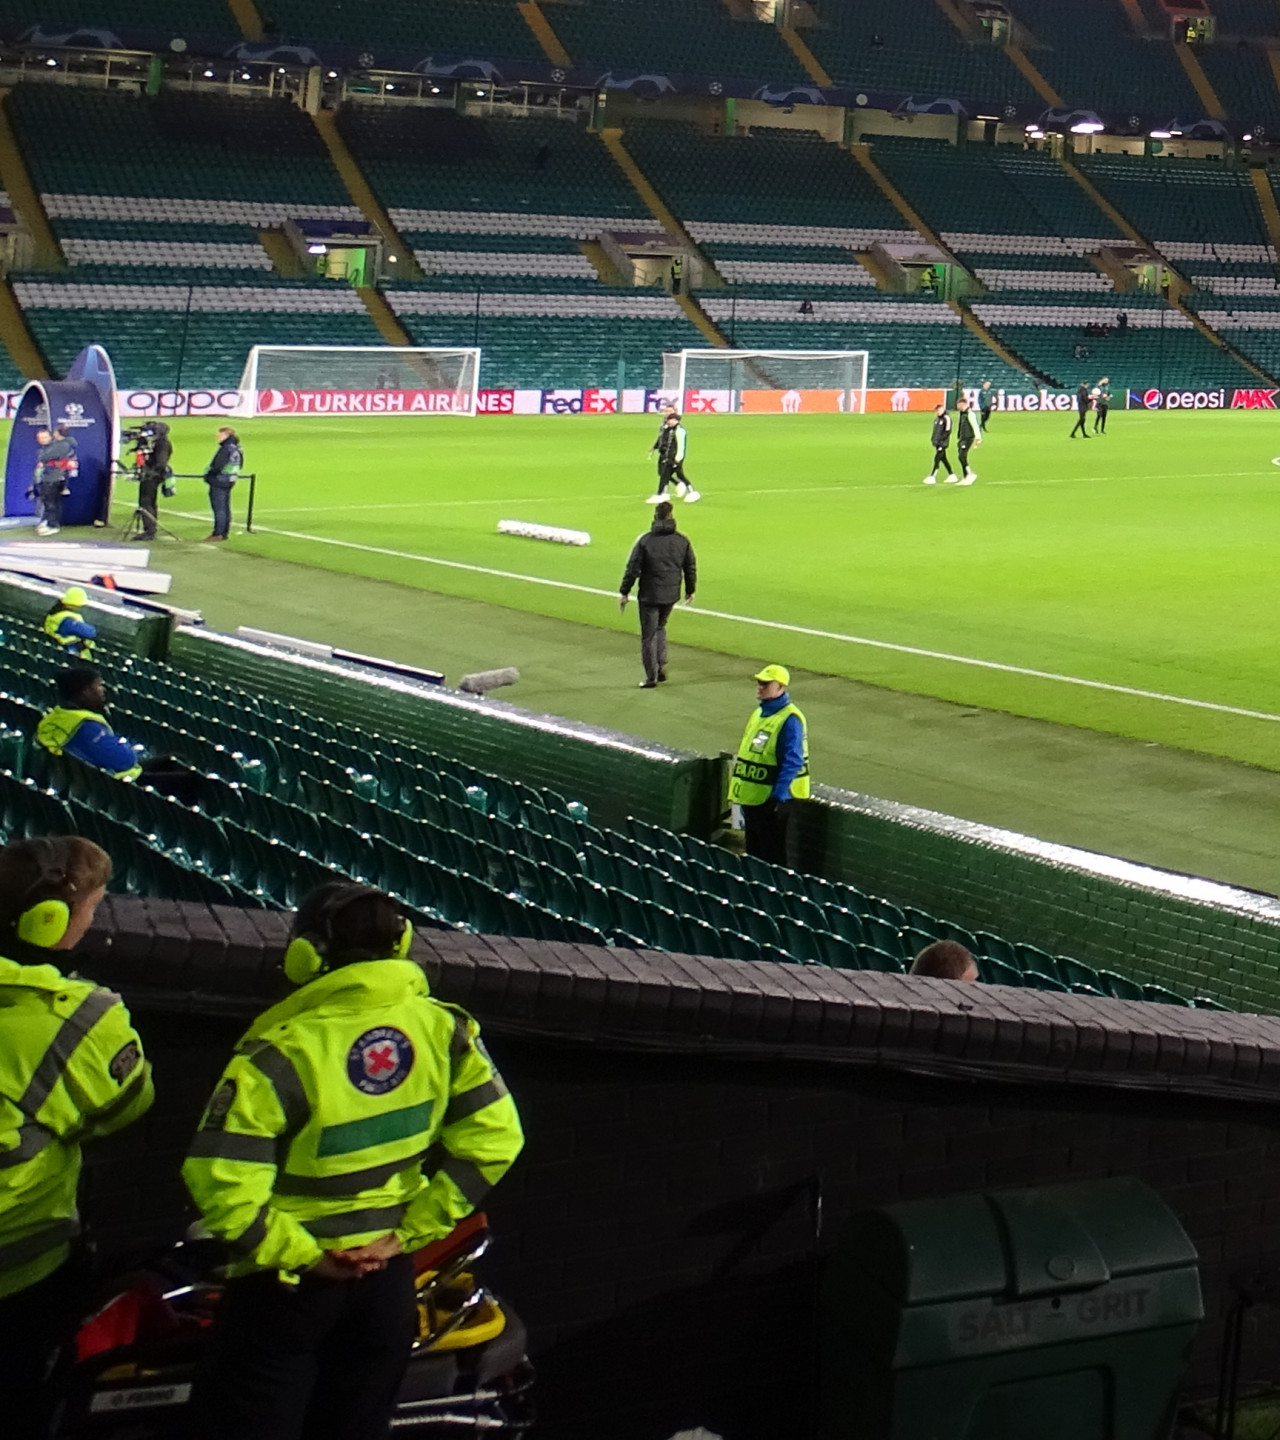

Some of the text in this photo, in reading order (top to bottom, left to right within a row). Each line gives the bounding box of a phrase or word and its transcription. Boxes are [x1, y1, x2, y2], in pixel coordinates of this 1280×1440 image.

[300, 393, 513, 412] TURKISH AIRLINES
[540, 389, 617, 413] FedEx
[644, 389, 717, 413] FeEx
[1166, 389, 1280, 410] pepsi MAX
[957, 1303, 1037, 1343] SALT
[1076, 1288, 1151, 1325] GRIT
